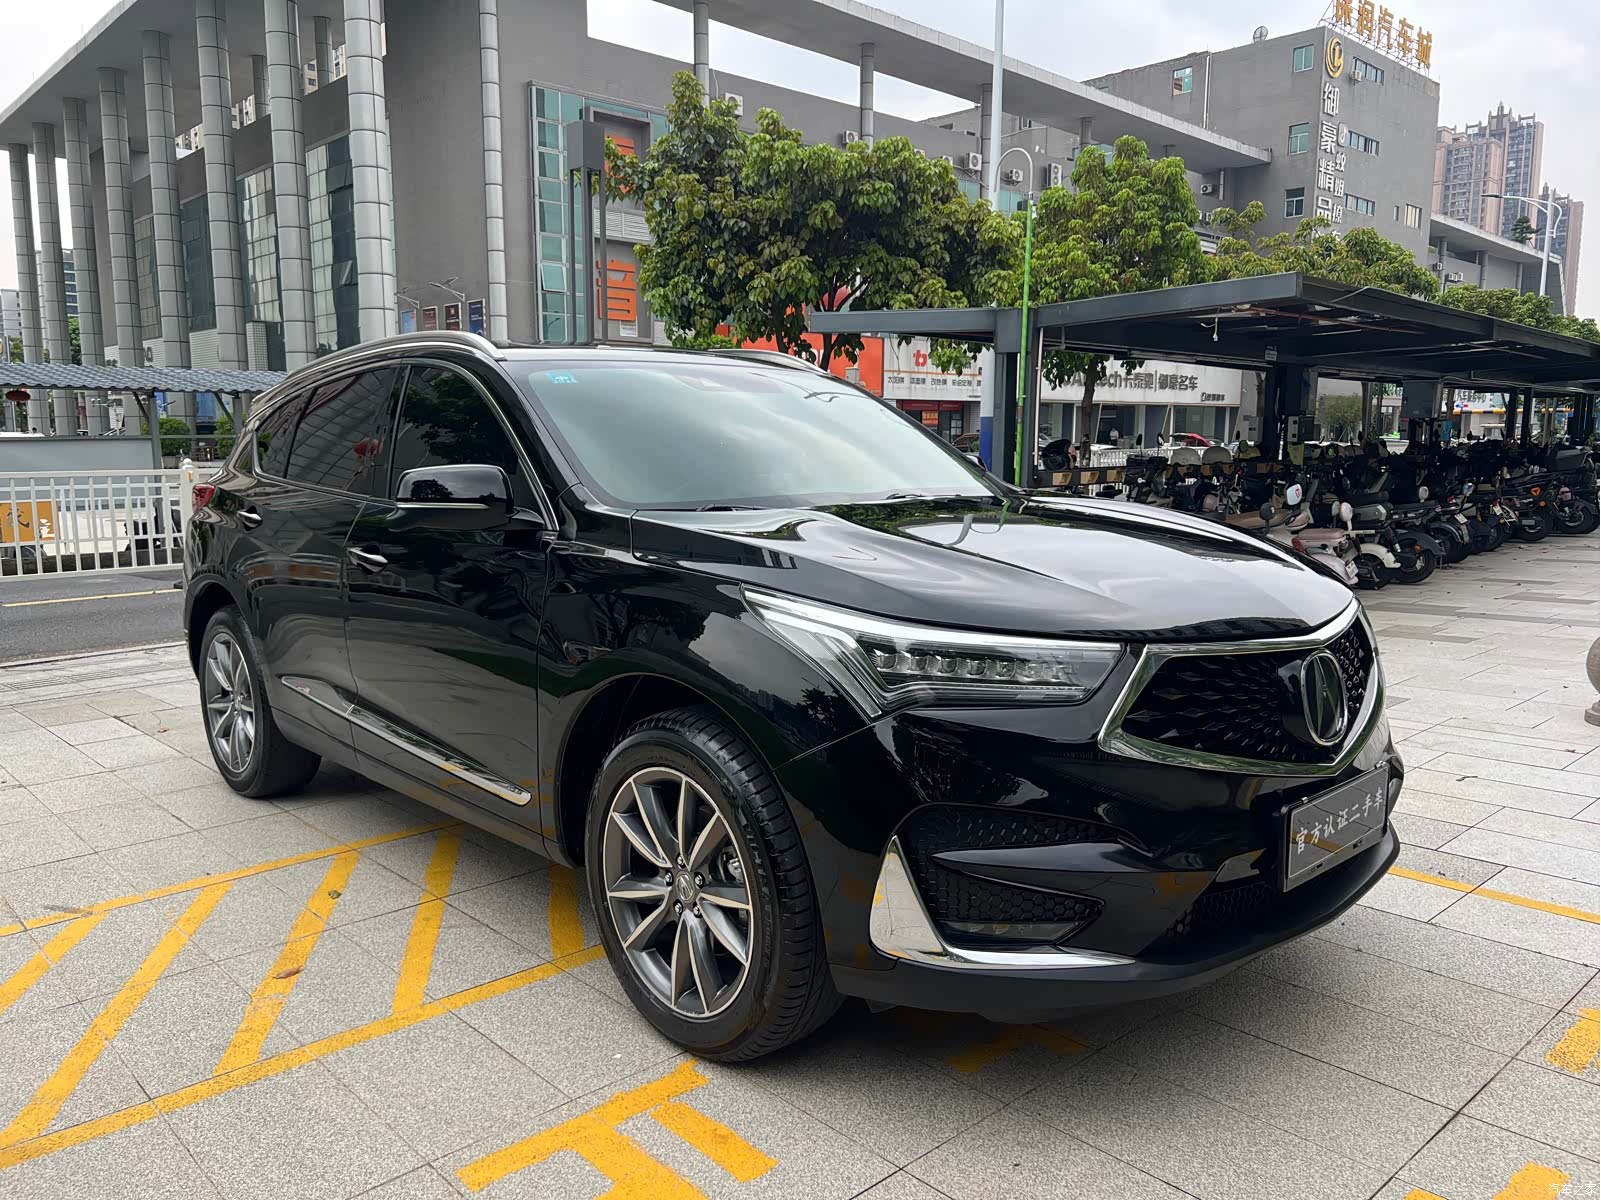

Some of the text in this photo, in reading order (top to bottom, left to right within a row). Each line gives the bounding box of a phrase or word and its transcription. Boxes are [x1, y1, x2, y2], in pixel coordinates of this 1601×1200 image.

[1312, 82, 1340, 241] 御豪精品
[1295, 787, 1384, 855] 官方认证二手车
